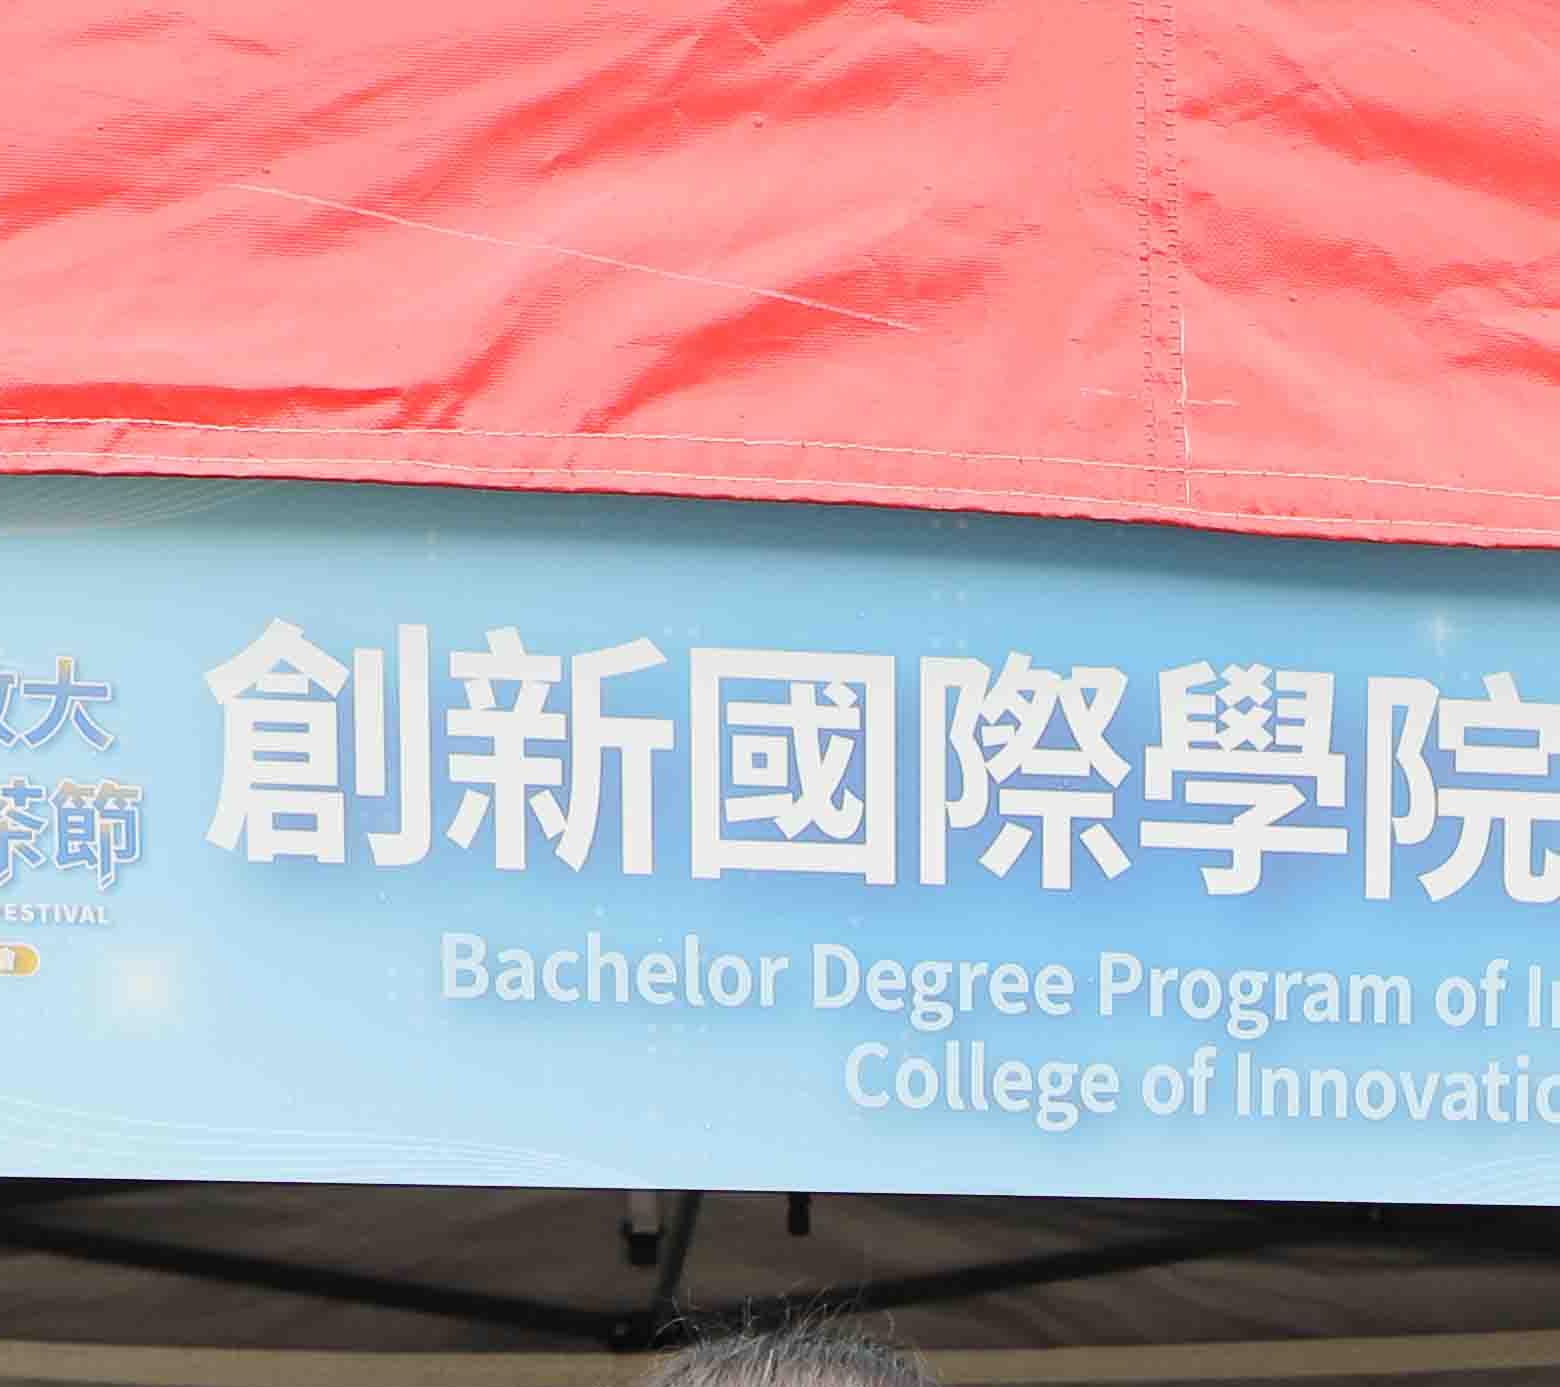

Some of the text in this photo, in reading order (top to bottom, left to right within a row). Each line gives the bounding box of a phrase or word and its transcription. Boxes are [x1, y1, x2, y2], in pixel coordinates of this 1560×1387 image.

[438, 930, 792, 1008] Bachelor
[813, 943, 1075, 1032] Degree
[1099, 951, 1411, 1040] Program
[1435, 959, 1510, 1027] of
[845, 1039, 1120, 1132] College
[1142, 1043, 1219, 1116] of
